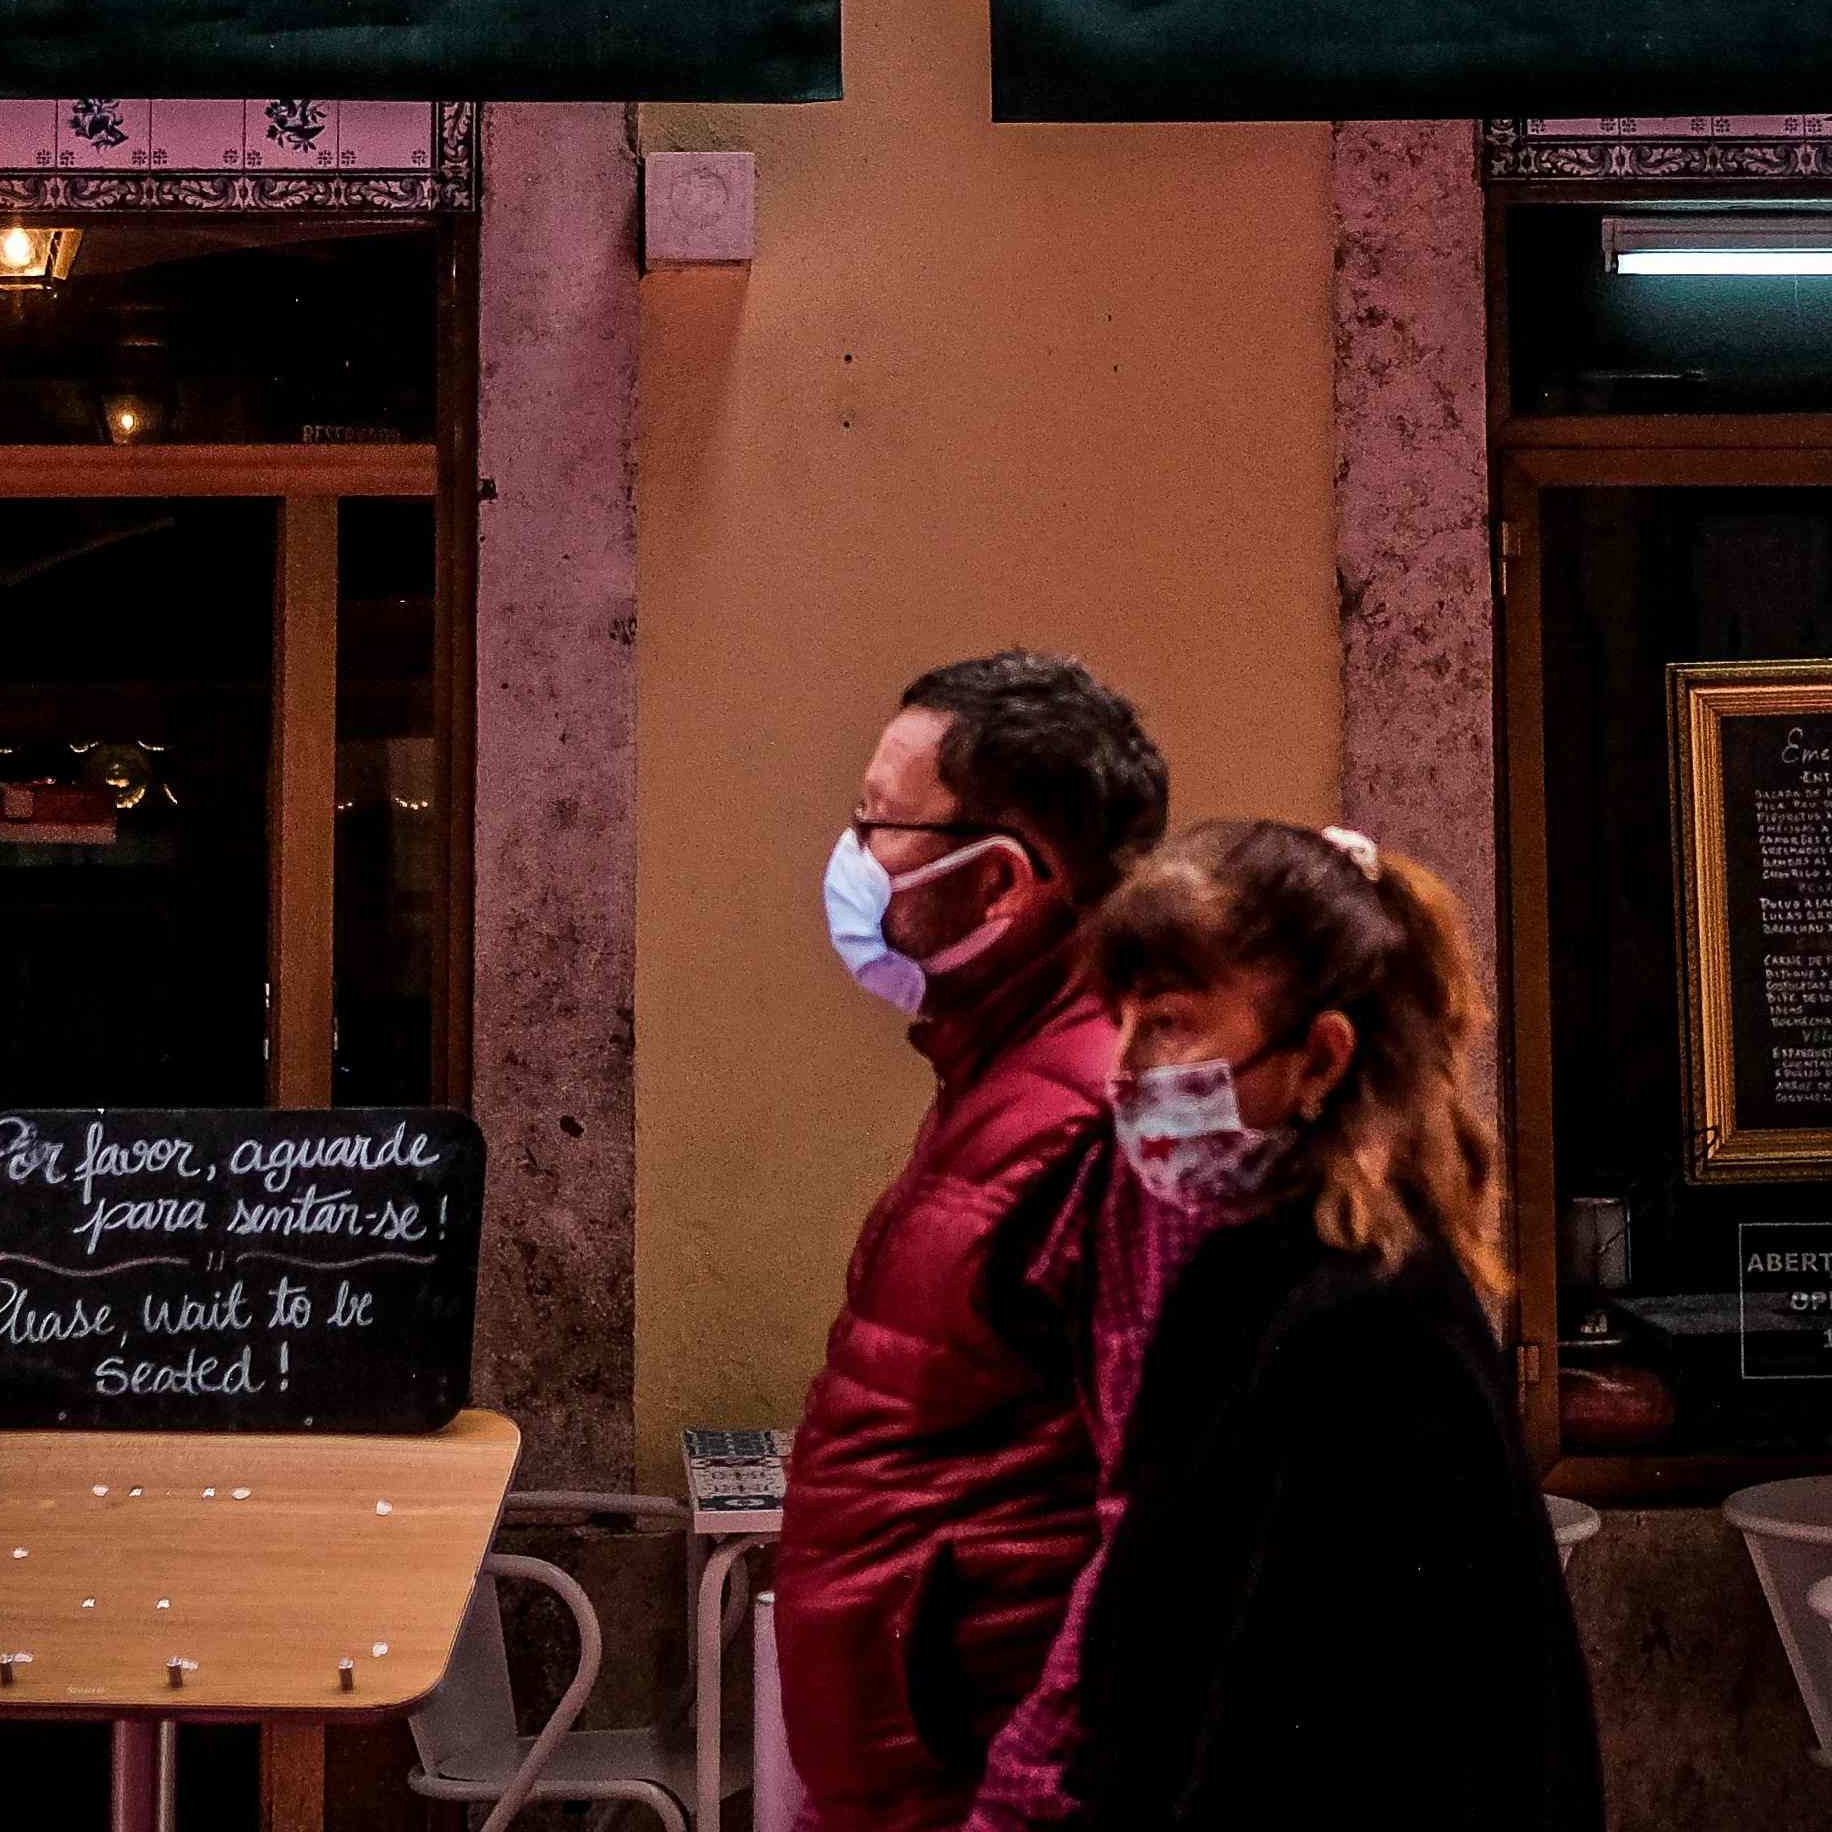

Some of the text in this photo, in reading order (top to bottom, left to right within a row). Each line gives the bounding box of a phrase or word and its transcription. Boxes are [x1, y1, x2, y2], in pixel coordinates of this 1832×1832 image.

[74, 1122, 217, 1204] favor,
[230, 1120, 441, 1193] aguarde
[73, 1195, 209, 1255] para
[269, 1276, 312, 1329] to
[326, 1280, 374, 1326] be
